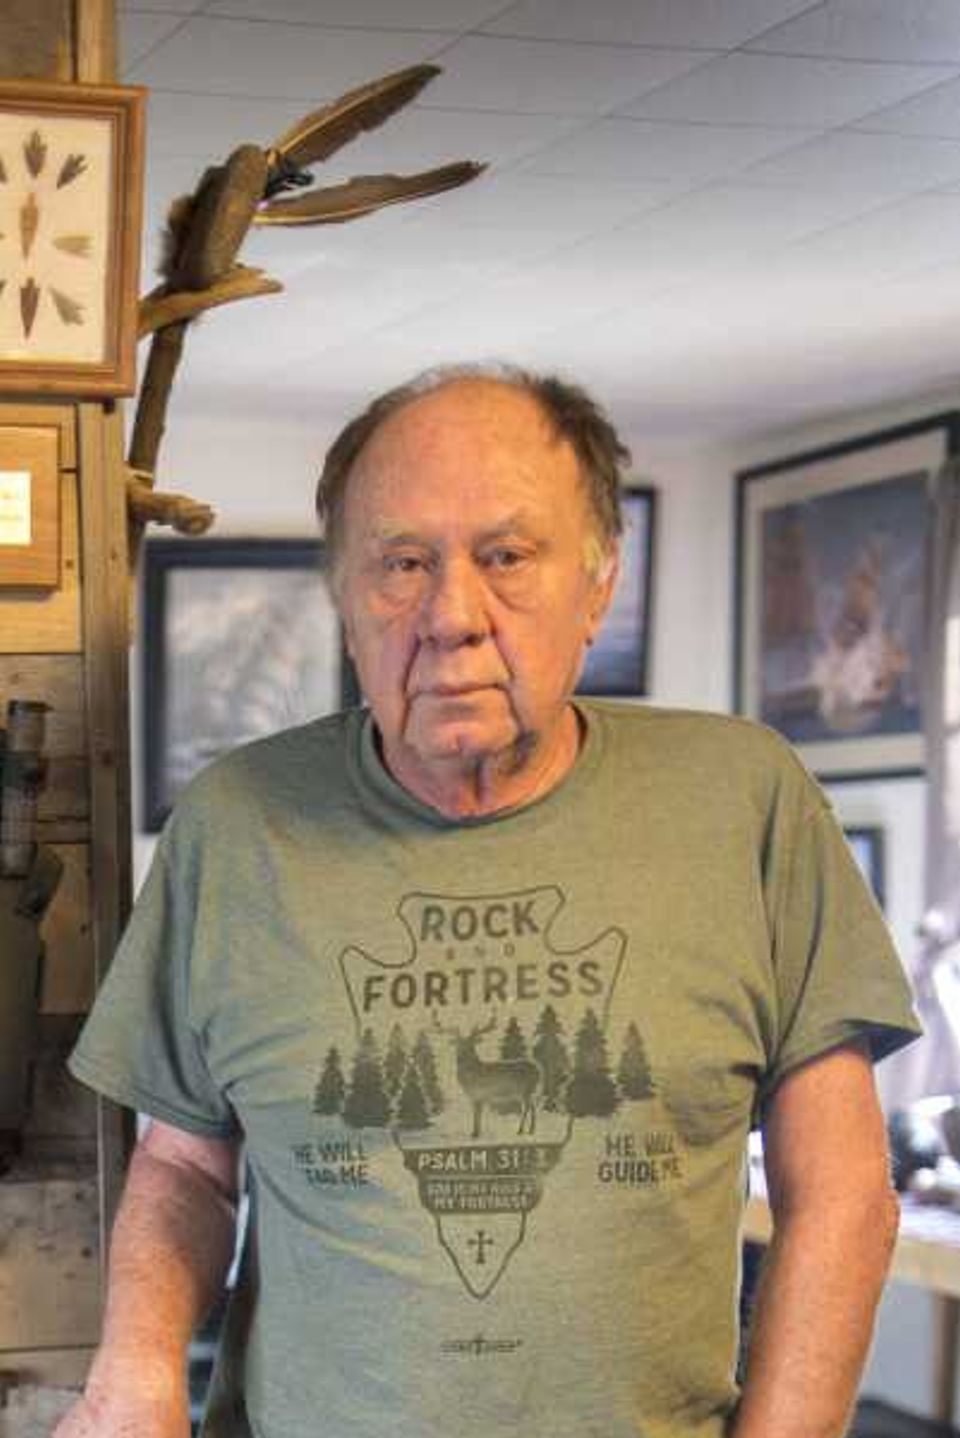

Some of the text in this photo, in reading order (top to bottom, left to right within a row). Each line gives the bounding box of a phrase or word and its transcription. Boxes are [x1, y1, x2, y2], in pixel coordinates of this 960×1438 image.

[420, 901, 539, 942] ROCK
[363, 960, 605, 1013] FORTRESS
[418, 1149, 488, 1171] PSALM
[598, 1159, 659, 1187] GUIDE
